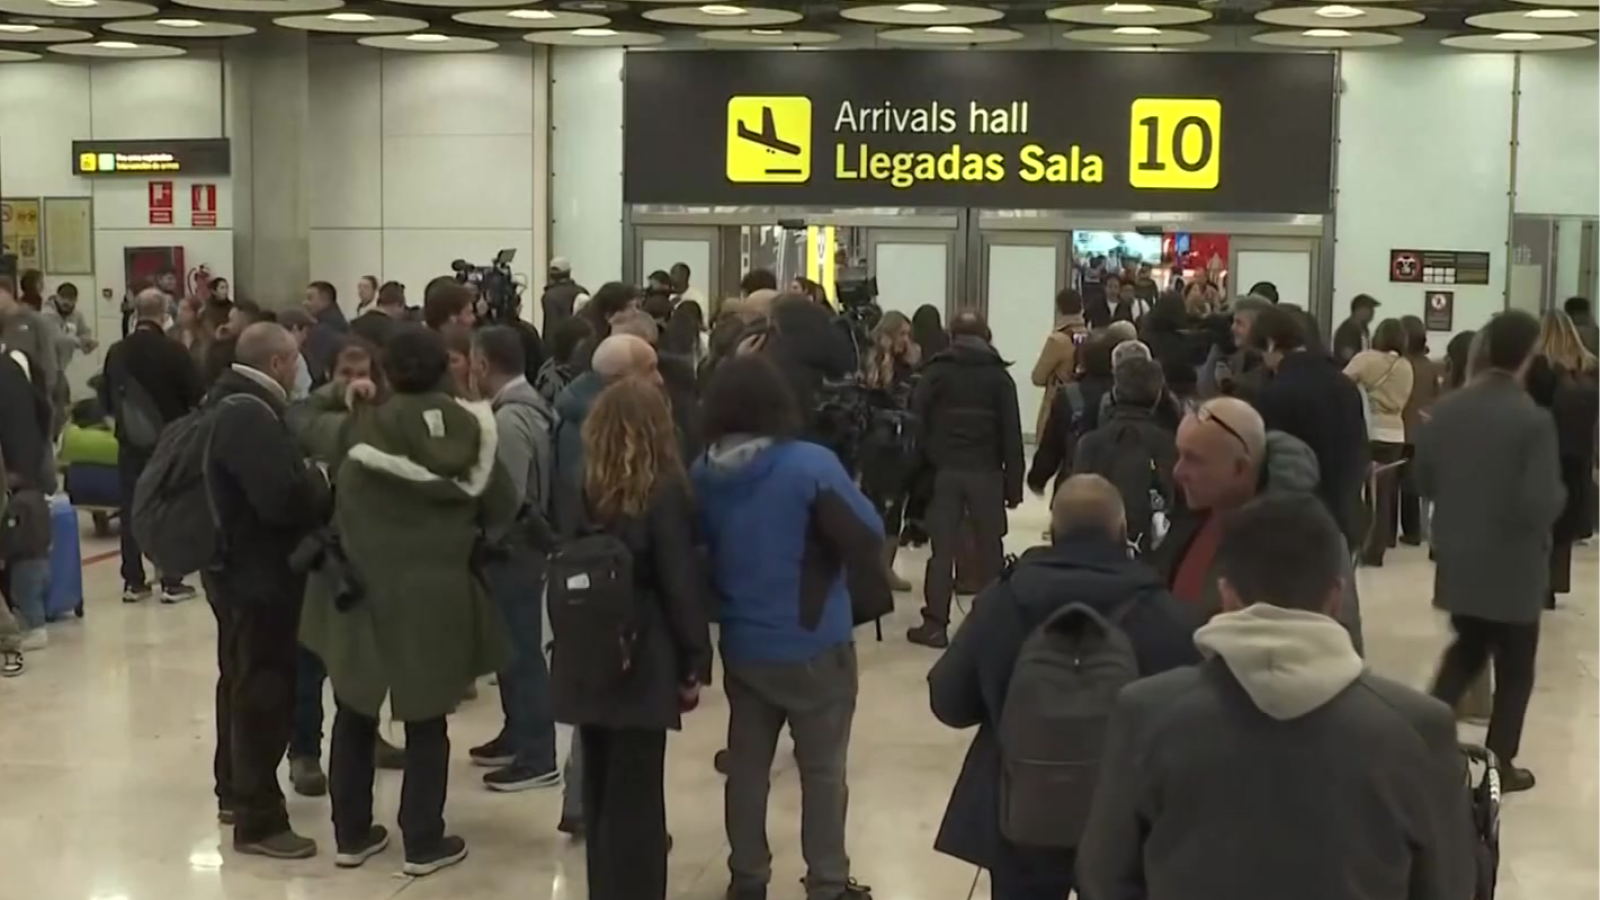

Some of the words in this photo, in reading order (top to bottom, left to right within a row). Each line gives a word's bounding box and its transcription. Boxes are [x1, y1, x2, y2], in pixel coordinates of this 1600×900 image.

[834, 100, 957, 134] Arrivals
[969, 100, 1029, 134] hall
[835, 143, 1006, 188] Llegadas
[1018, 143, 1104, 184] Sala
[1137, 115, 1212, 172] 10
